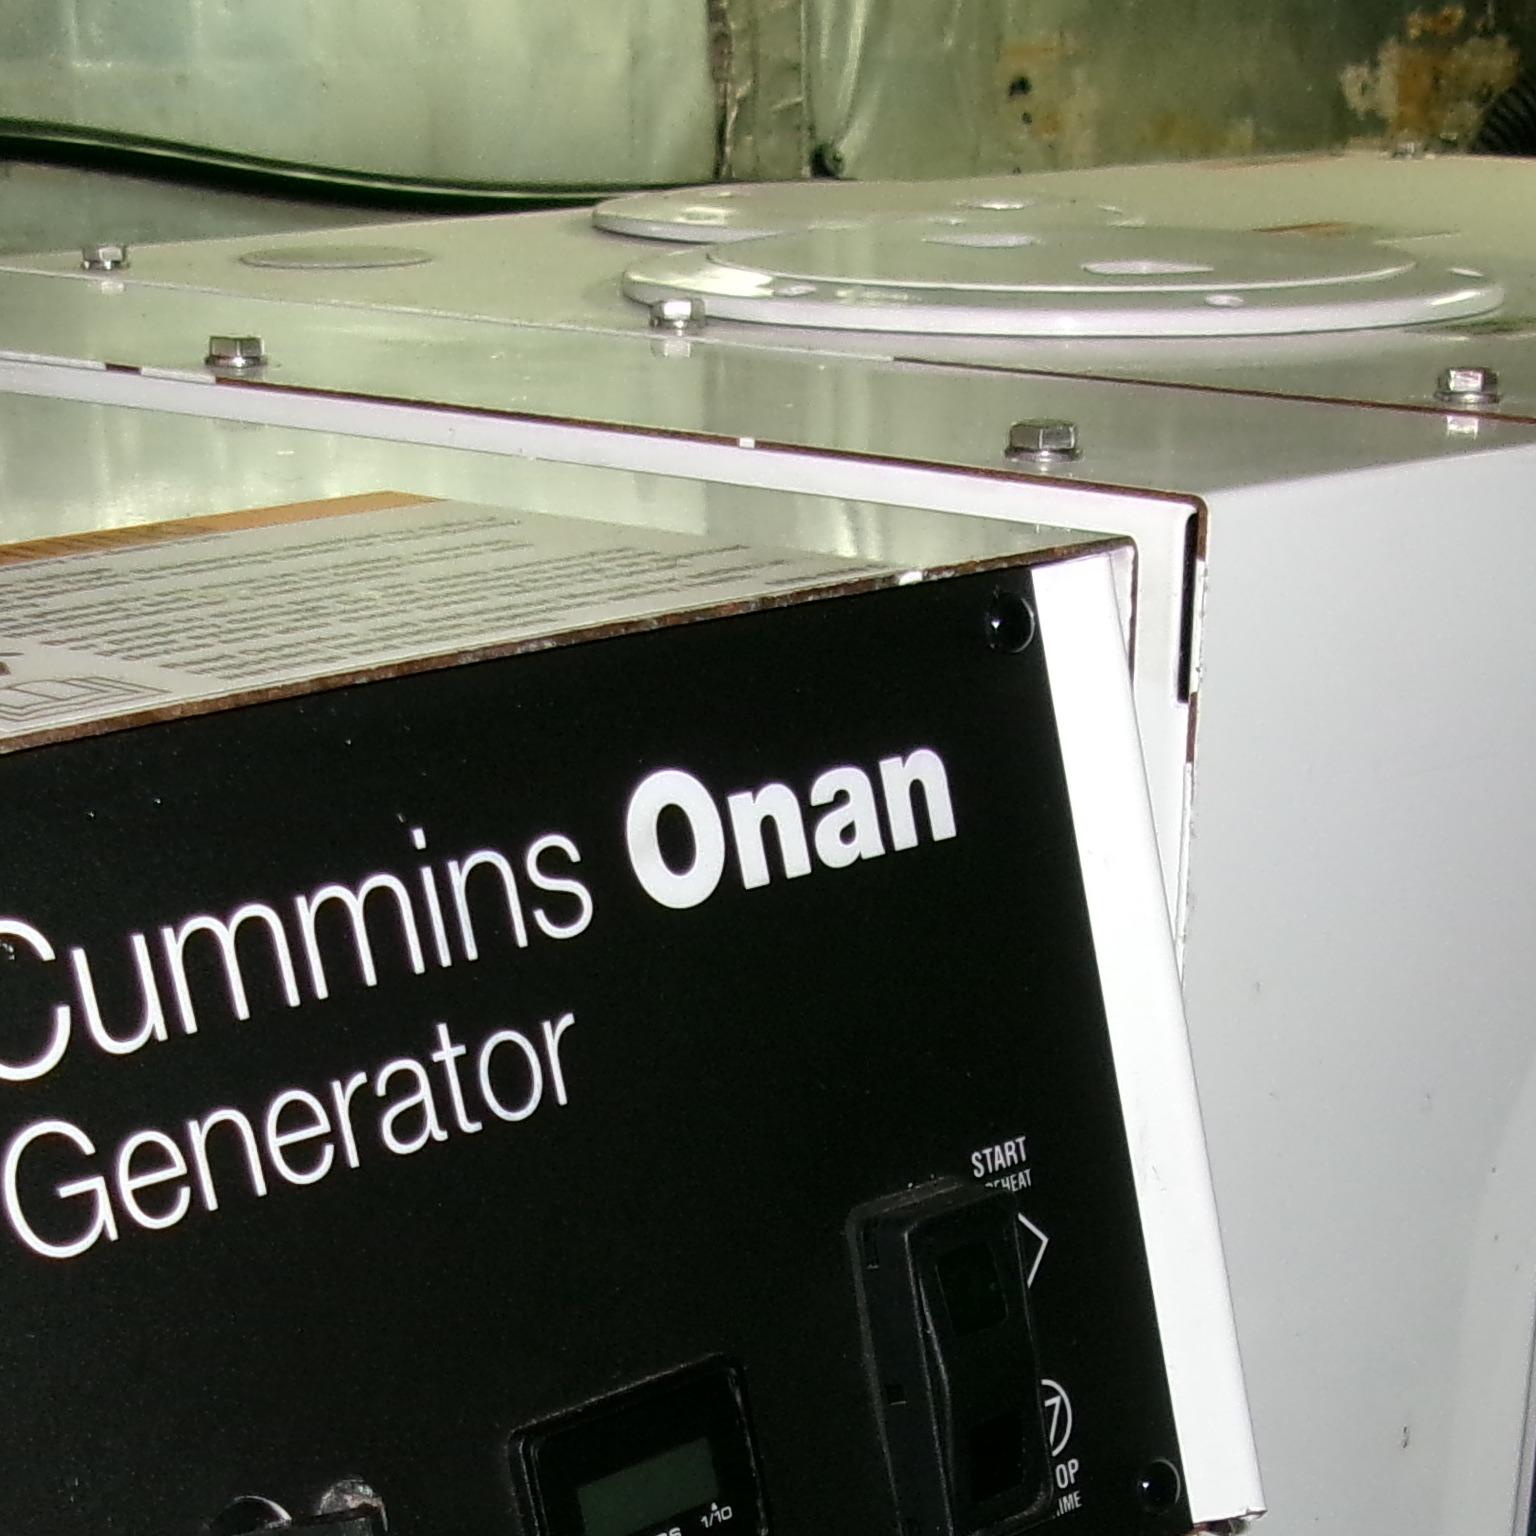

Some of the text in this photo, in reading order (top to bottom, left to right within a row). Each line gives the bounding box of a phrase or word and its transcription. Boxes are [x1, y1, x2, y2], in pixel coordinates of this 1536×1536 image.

[625, 747, 959, 909] Onan
[1, 1012, 577, 1260] Generator
[971, 1136, 1026, 1178] START
[700, 1504, 733, 1528] 1/10
